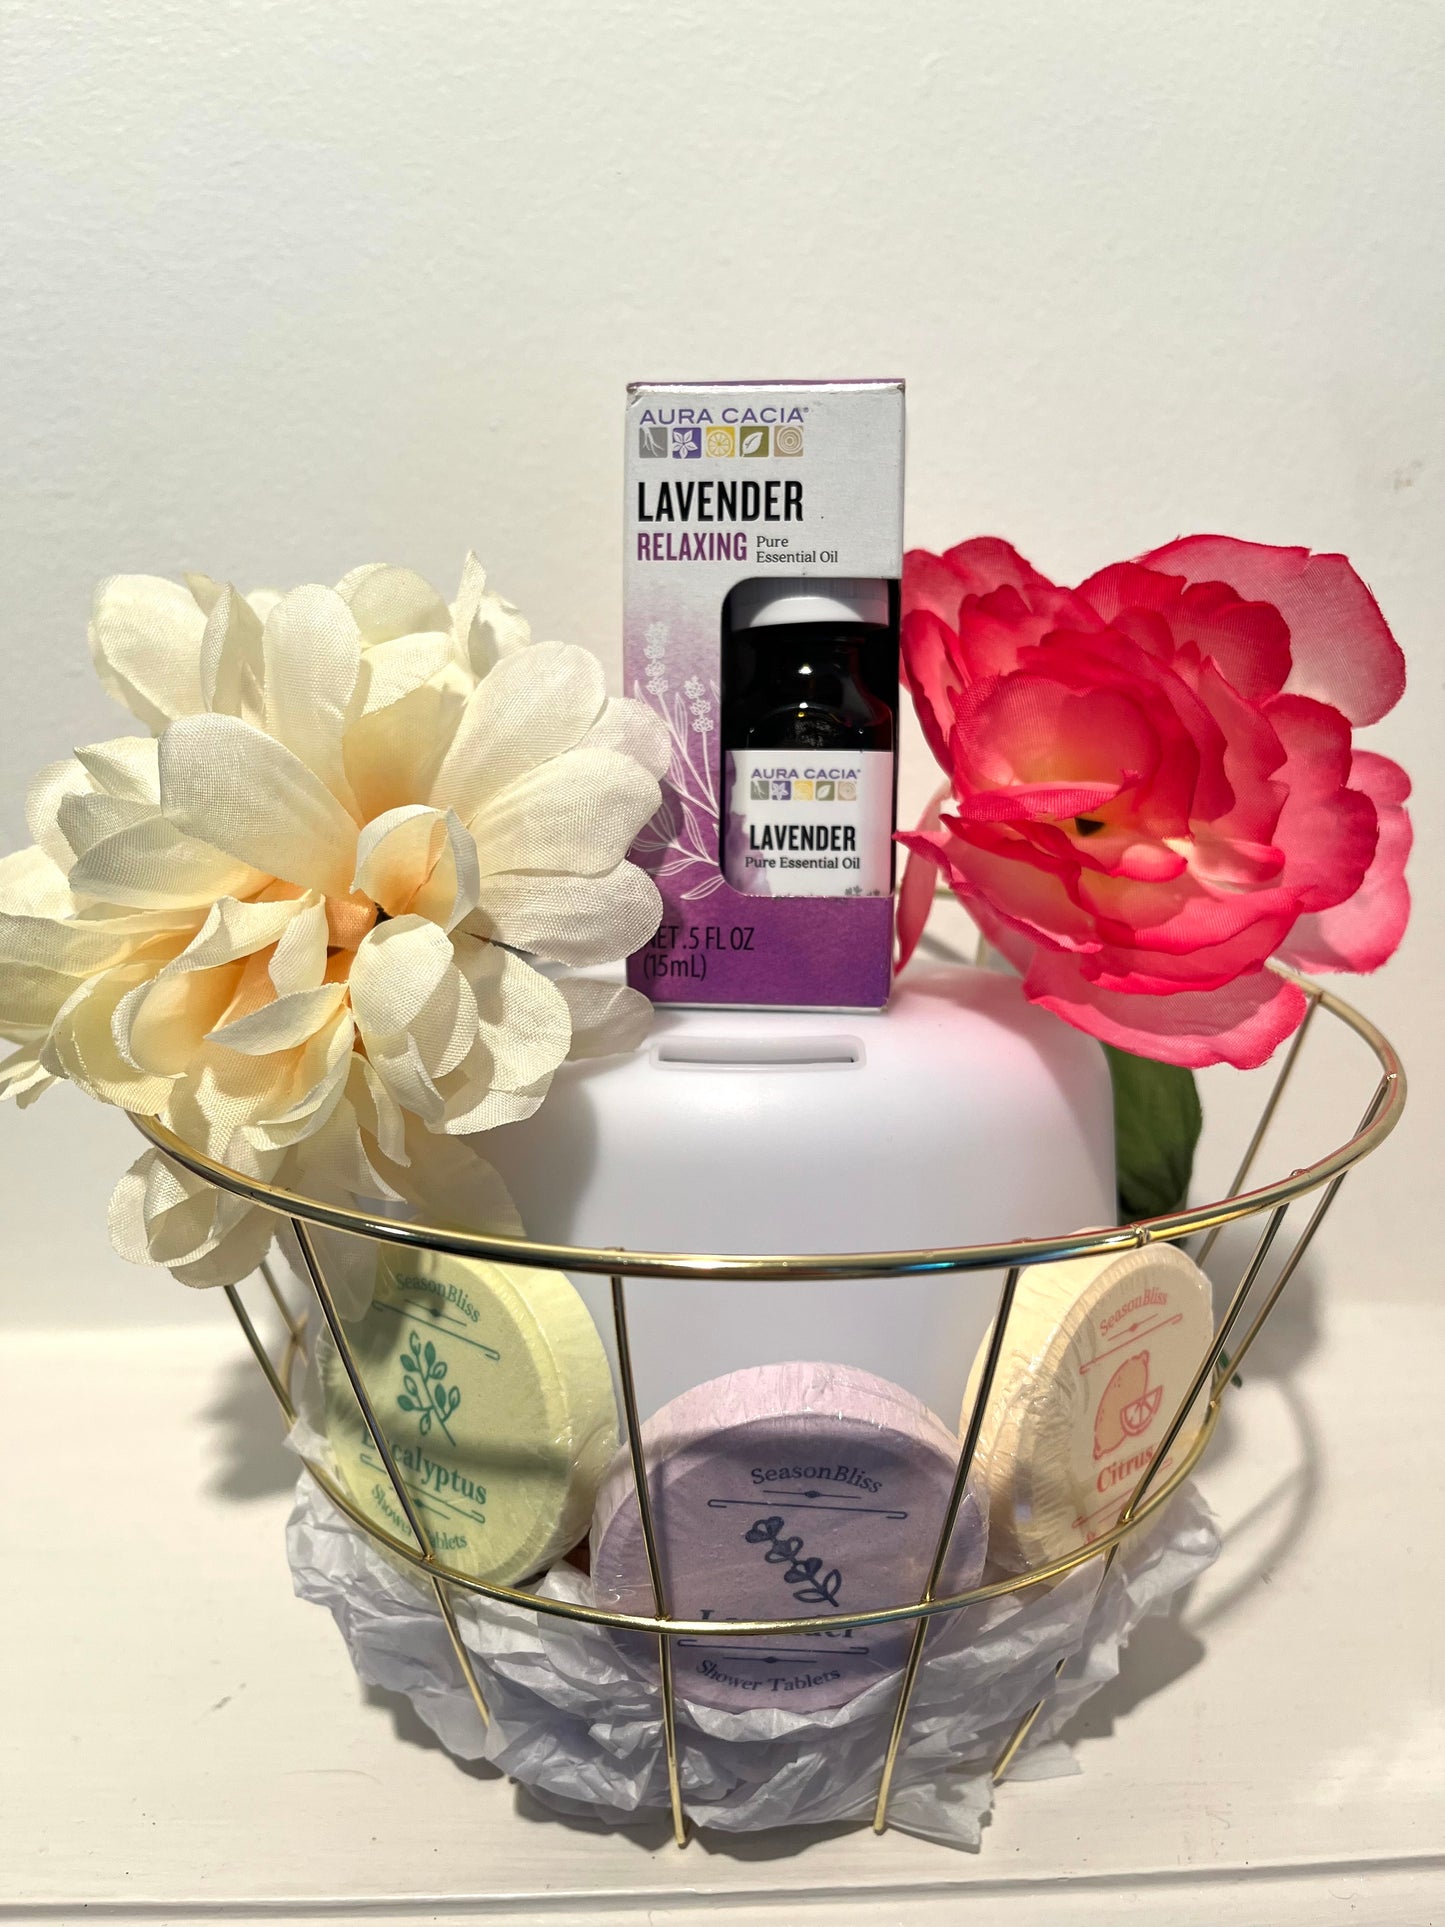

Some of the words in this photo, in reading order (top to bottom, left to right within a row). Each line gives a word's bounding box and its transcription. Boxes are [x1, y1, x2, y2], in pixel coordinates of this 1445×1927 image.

[639, 408, 714, 425] AURA
[637, 480, 804, 523] LAVENDER
[637, 532, 748, 562] RELAXING
[756, 536, 789, 549] Pure
[756, 551, 816, 563] Essential
[819, 551, 839, 563] Oil
[751, 768, 800, 780] AURA
[749, 824, 857, 852] LAVENDER
[745, 856, 777, 869] Pure
[779, 857, 839, 869] Essential
[841, 857, 861, 870] Oil
[682, 926, 700, 950] .5
[705, 926, 727, 951] FL
[730, 927, 755, 951] OZ
[643, 952, 707, 982] (15mL)
[395, 1273, 480, 1323] SeasonBliss
[1099, 1286, 1169, 1337] SeasonBliss
[750, 1465, 883, 1493] SeasonBliss
[1096, 1445, 1154, 1493] Citrus
[430, 1530, 468, 1550] ablets
[695, 1659, 763, 1692] Shower
[767, 1669, 841, 1692] Tablets
